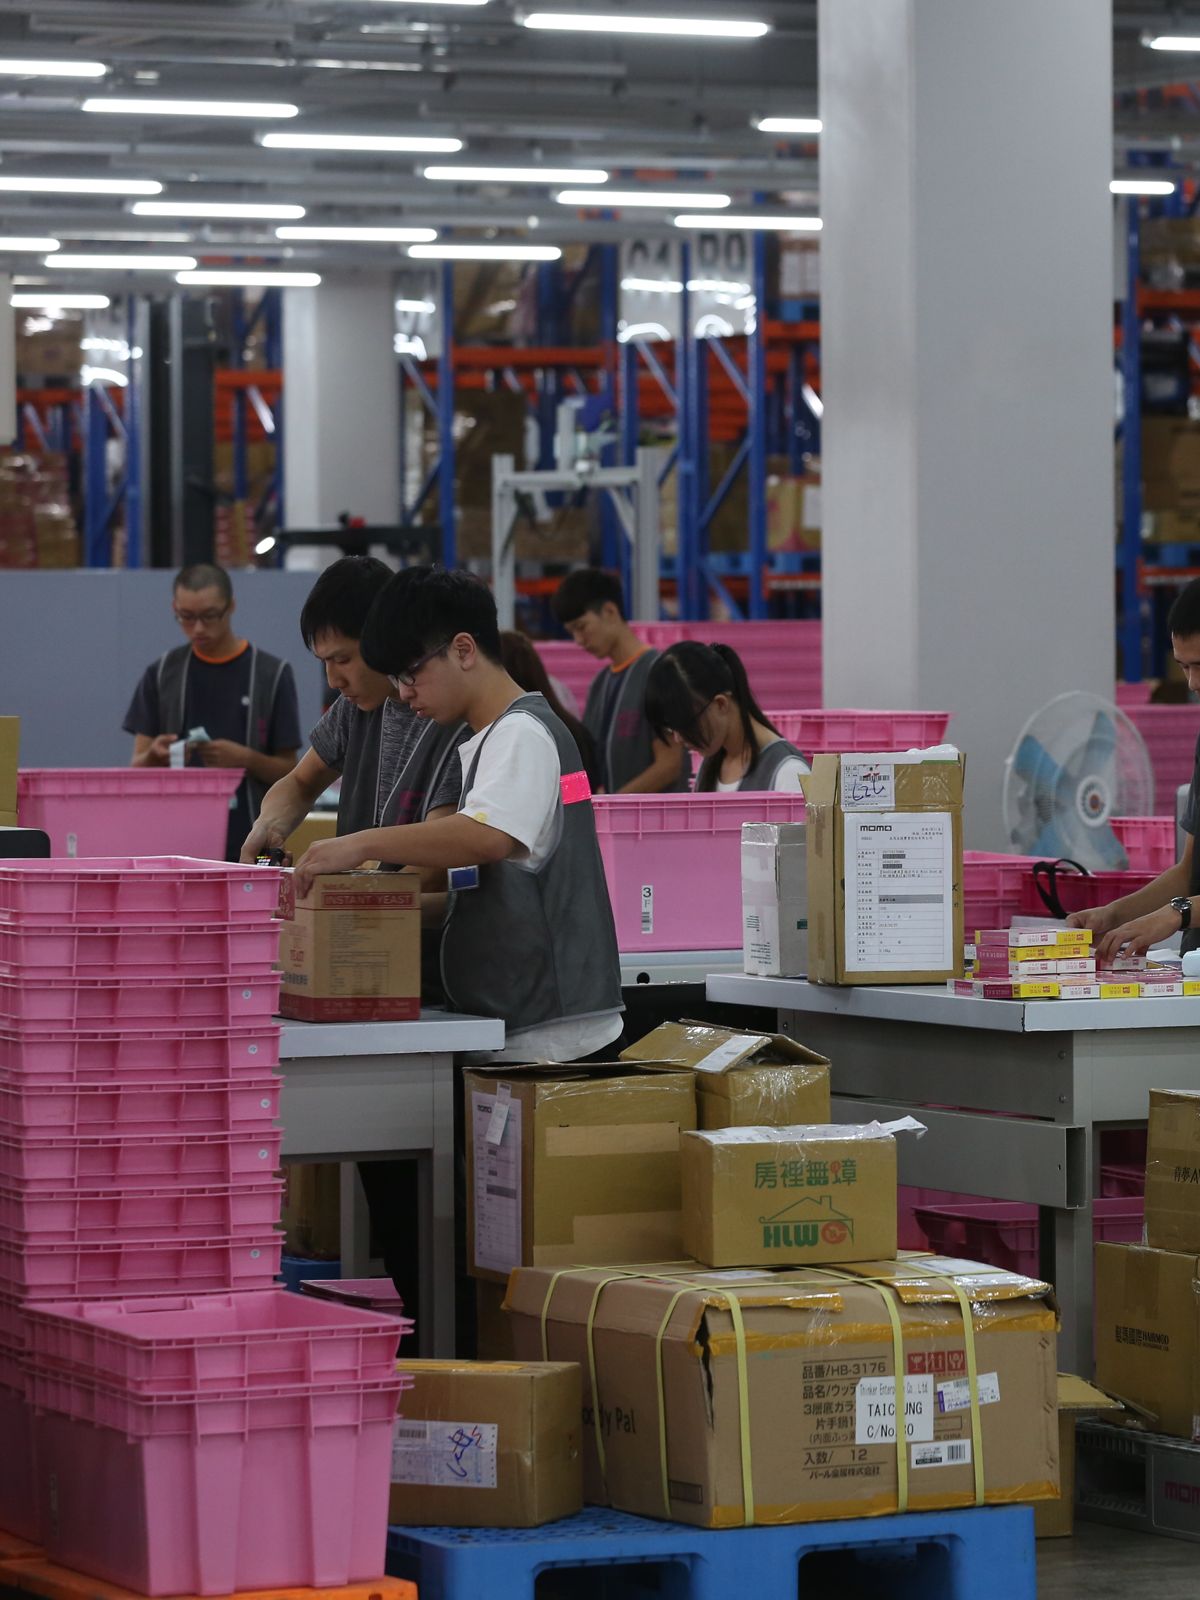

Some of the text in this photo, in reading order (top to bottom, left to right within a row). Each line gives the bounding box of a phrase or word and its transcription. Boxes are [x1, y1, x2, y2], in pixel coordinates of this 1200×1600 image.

[642, 887, 652, 898] 3
[328, 895, 412, 906] INSTANT YEAST
[868, 1401, 923, 1418] TAICUNG
[615, 1406, 637, 1434] Pal
[850, 1449, 868, 1462] 12
